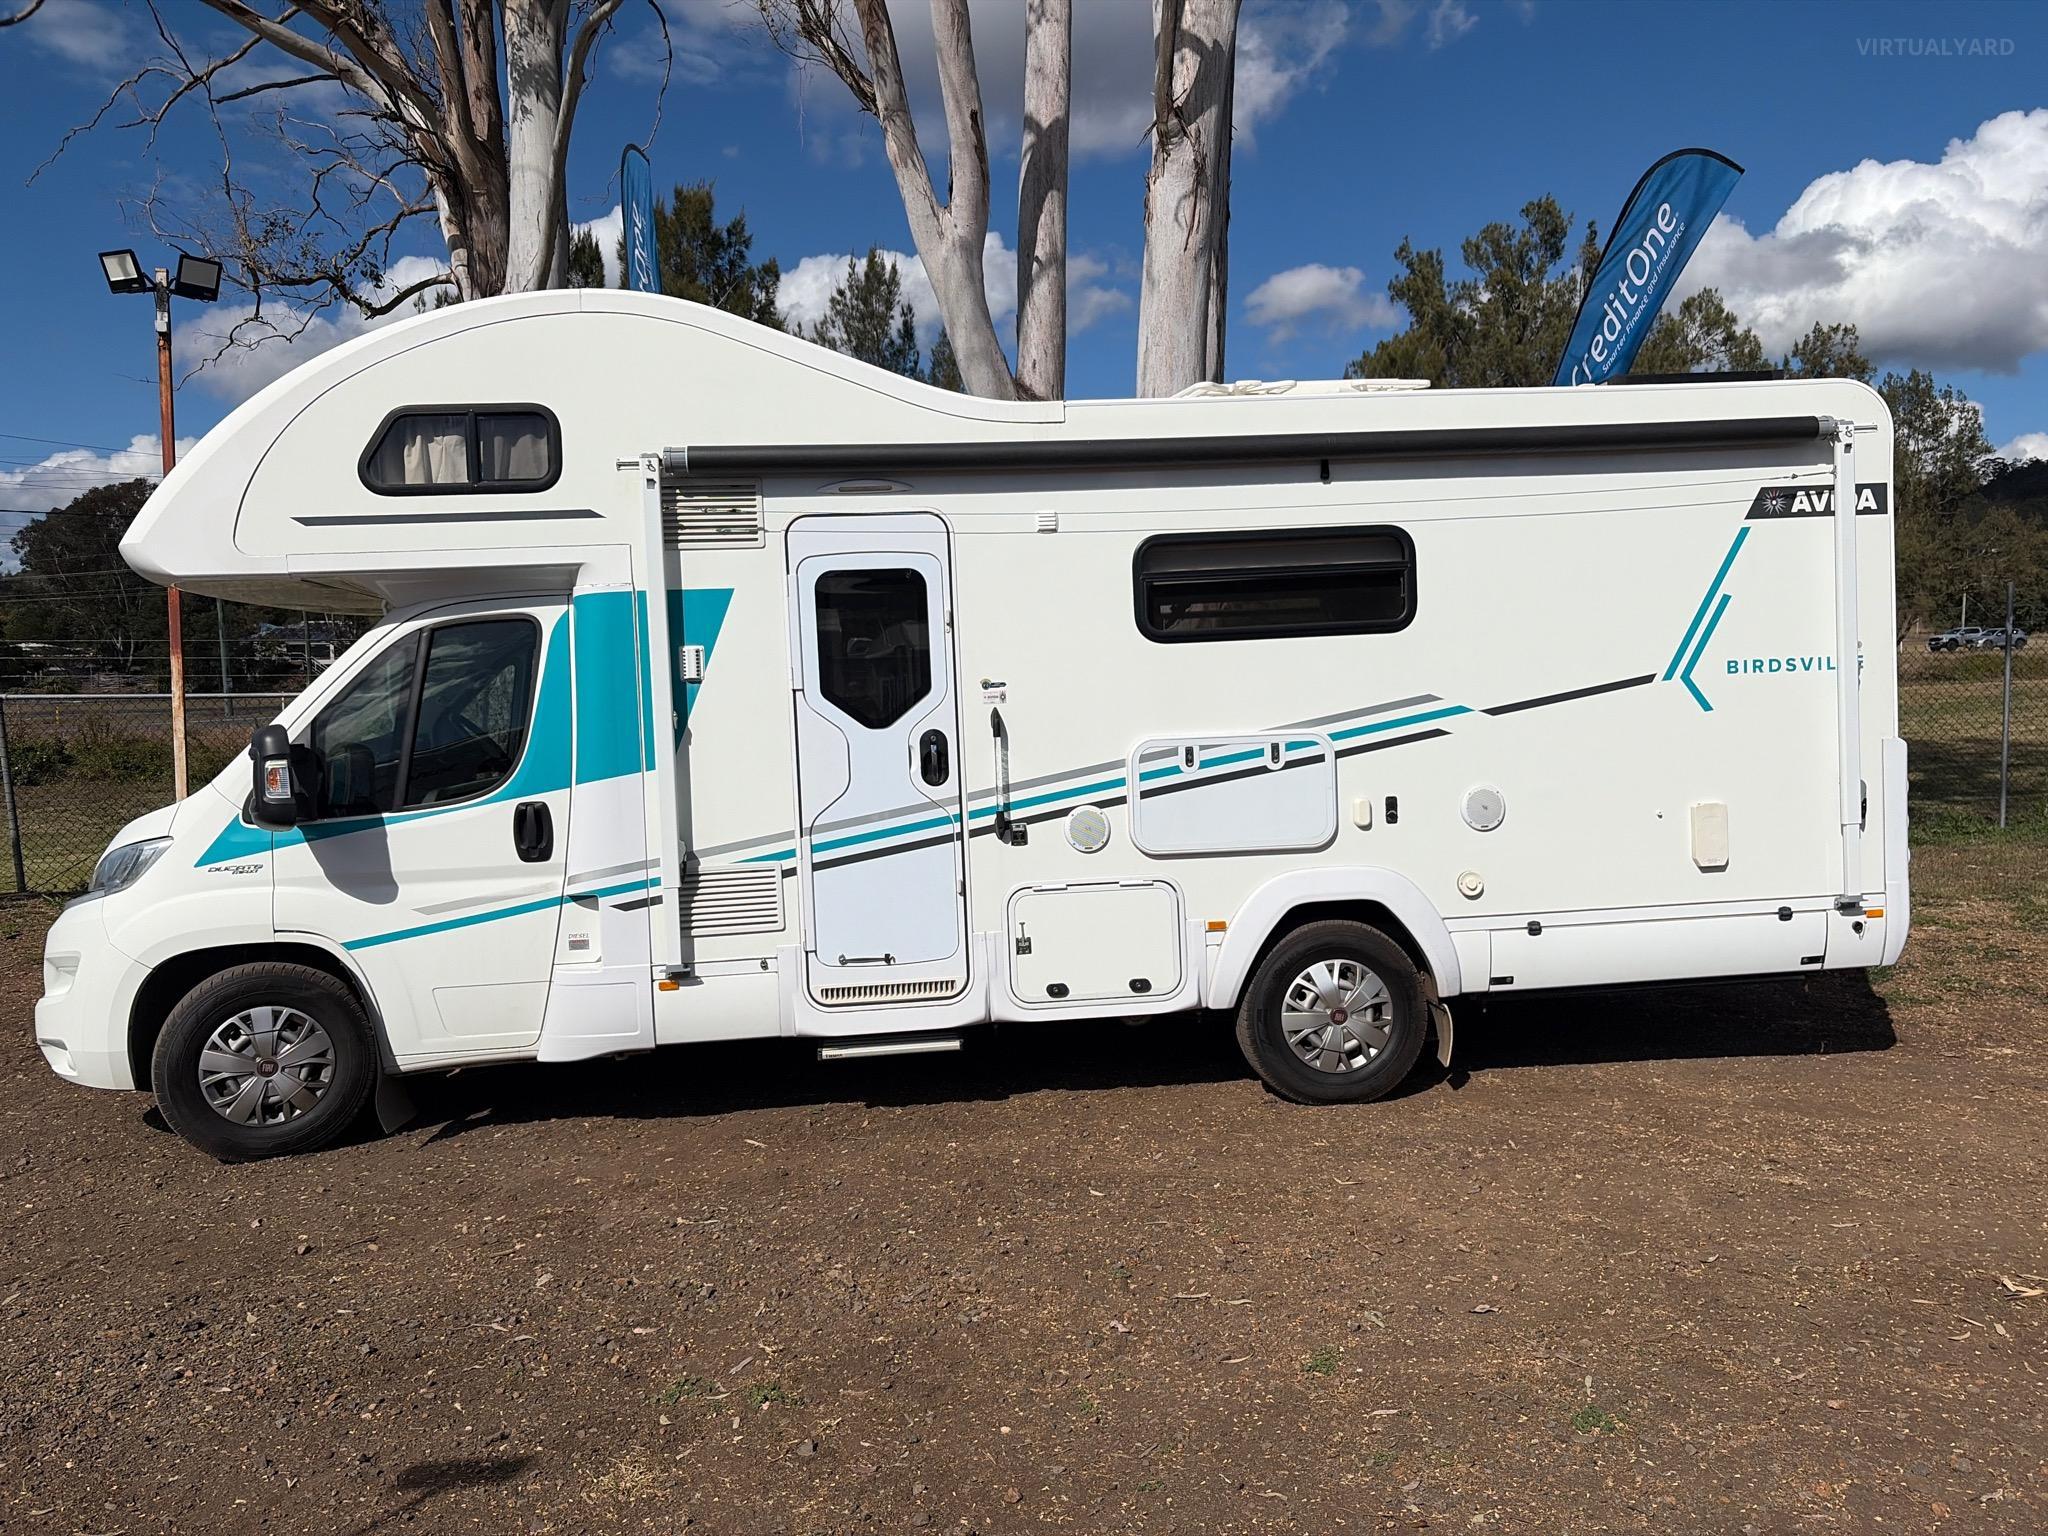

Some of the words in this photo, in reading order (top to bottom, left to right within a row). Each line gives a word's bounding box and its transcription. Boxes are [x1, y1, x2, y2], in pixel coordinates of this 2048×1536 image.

[1602, 333, 1627, 374] Smarter
[1625, 295, 1649, 336] Finance
[1646, 271, 1659, 295] and
[1656, 222, 1686, 275] Insurance
[1790, 488, 1878, 513] AVIA
[208, 864, 263, 873] DUCATO
